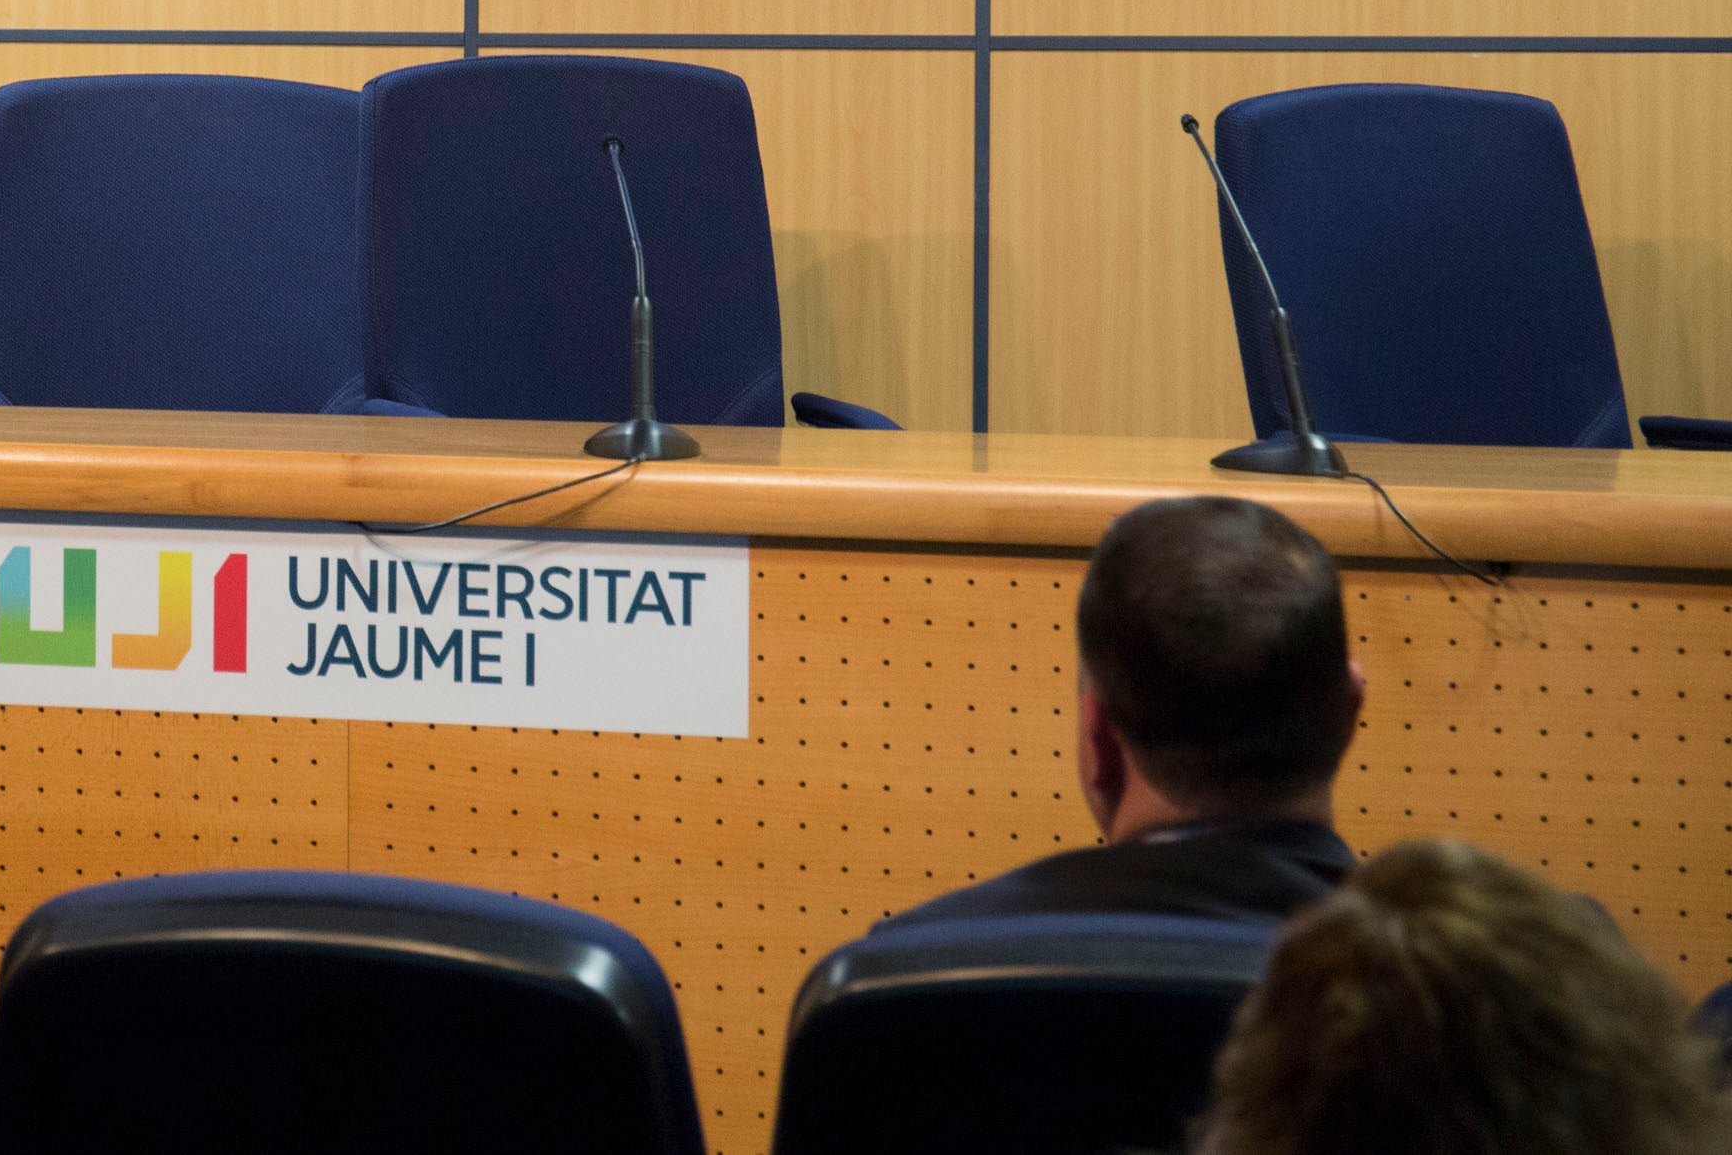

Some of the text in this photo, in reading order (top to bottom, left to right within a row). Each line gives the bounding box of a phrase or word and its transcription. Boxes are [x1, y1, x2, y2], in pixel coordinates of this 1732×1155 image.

[288, 556, 706, 628] UNIVERSITAT
[287, 623, 535, 686] JAUME I
